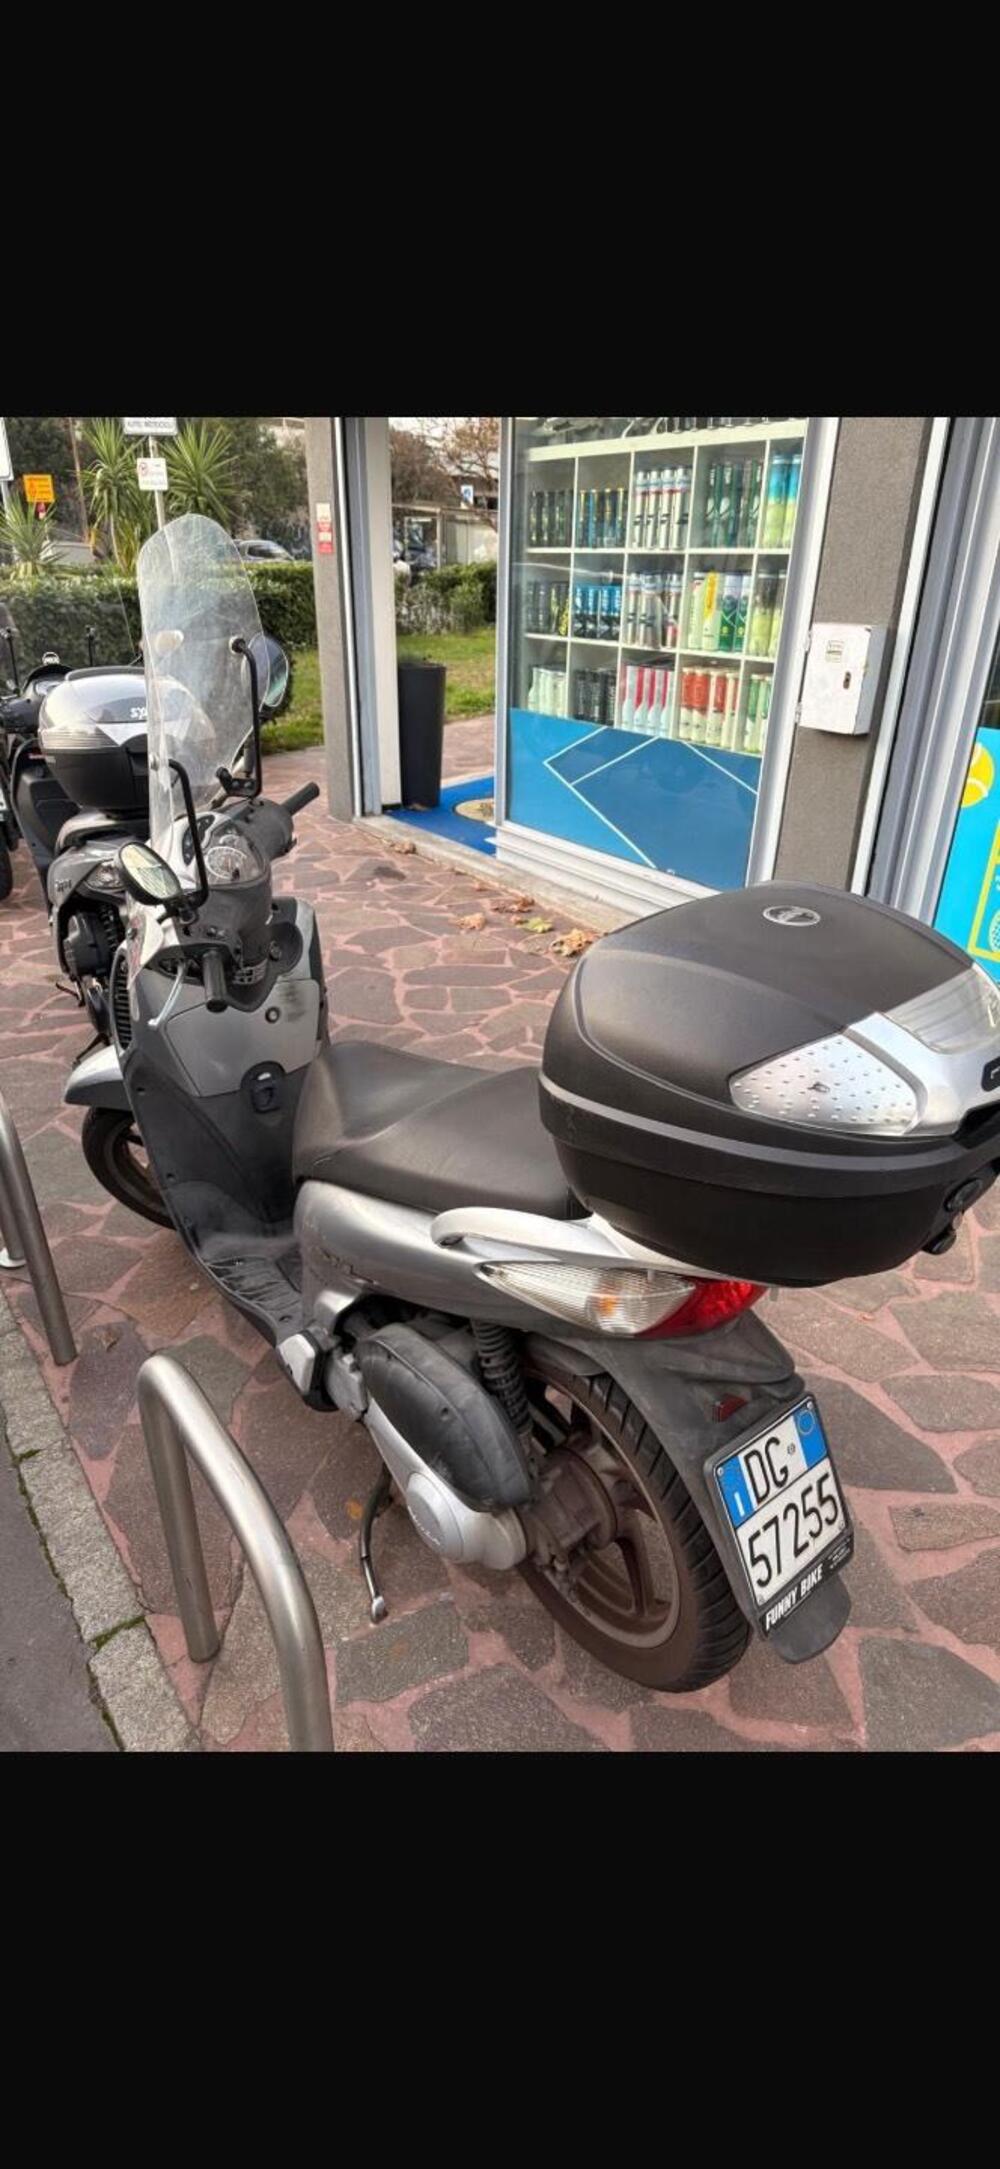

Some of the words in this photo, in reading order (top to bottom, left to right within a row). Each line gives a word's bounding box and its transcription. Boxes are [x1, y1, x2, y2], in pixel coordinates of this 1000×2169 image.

[744, 1436, 788, 1503] DG
[748, 1473, 838, 1588] 57255
[765, 1587, 798, 1631] FUNNY
[800, 1563, 823, 1597] BIKE
